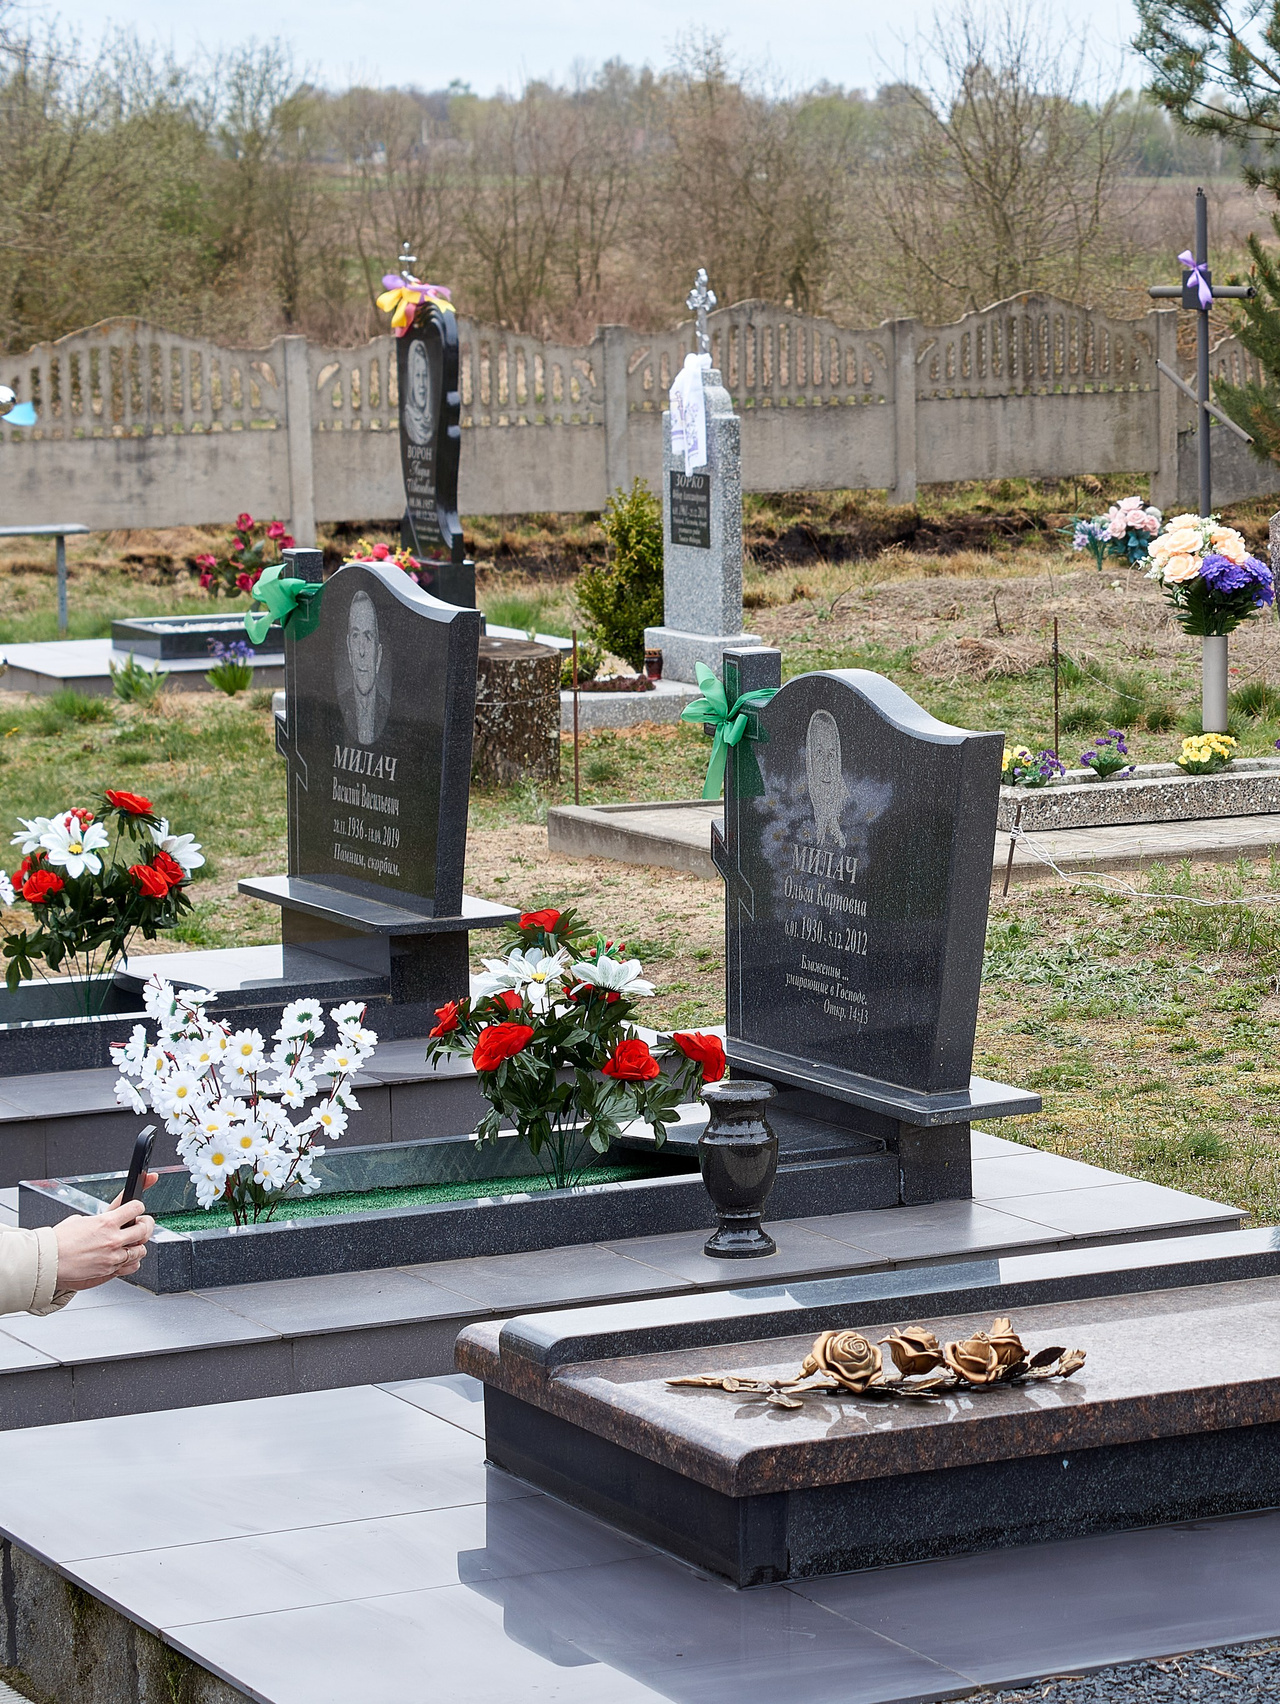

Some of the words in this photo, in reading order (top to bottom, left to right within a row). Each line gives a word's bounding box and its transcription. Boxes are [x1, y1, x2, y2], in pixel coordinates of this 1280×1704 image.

[407, 445, 433, 461] ВОРОН
[332, 745, 399, 781] МИЛАЧ
[332, 776, 361, 807] Василий
[361, 783, 400, 817] Васильевич
[348, 816, 364, 840] 1936
[382, 826, 400, 849] 2019
[333, 843, 366, 869] Помним,
[367, 856, 400, 877] скорбим.
[791, 843, 860, 884] МИЛАЧ
[784, 875, 814, 905] Ольга
[816, 883, 868, 918] Карповна
[801, 915, 823, 944] 1930
[844, 927, 868, 956] 2012
